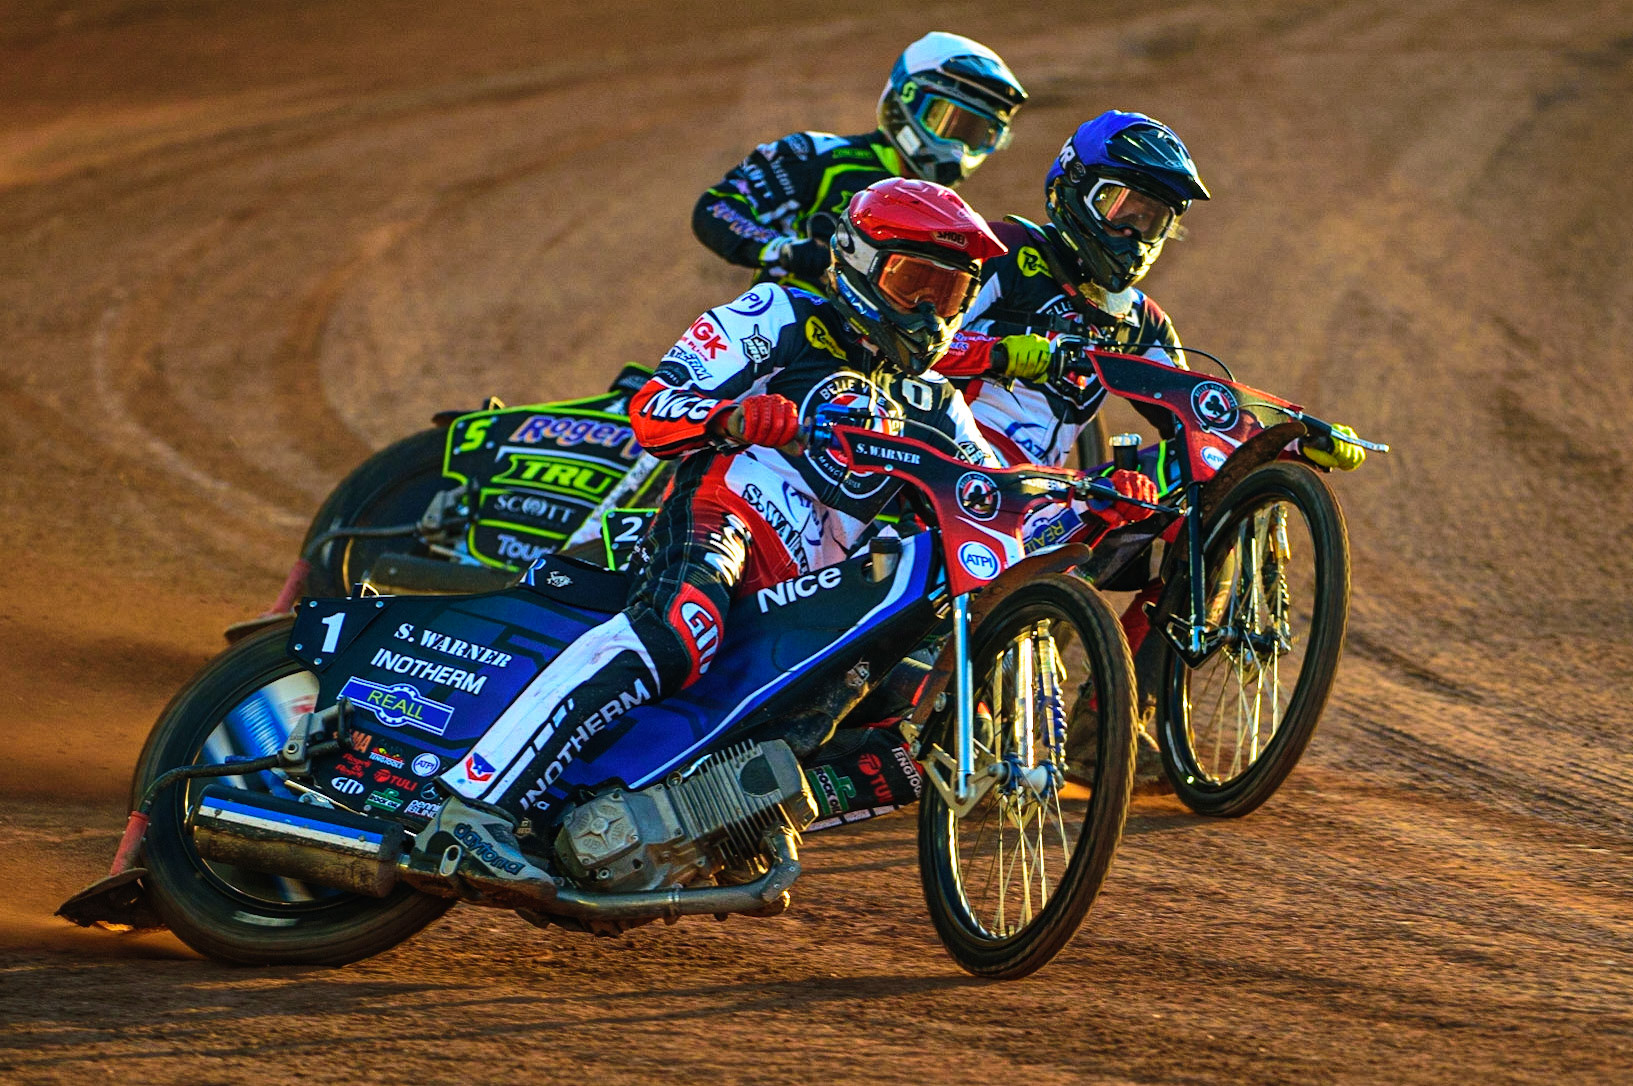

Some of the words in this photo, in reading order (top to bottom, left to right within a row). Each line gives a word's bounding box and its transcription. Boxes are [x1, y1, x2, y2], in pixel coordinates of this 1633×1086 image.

[690, 316, 728, 360] GK
[508, 414, 634, 447] Roger
[869, 445, 921, 465] WARNER
[493, 494, 576, 523] SCOTT
[614, 516, 643, 542] 2
[757, 567, 842, 614] Nice
[321, 612, 346, 653] 1
[394, 622, 415, 643] S.
[420, 629, 513, 668] WARNER
[370, 647, 488, 695] INOTHERM
[366, 688, 423, 721] REALL
[520, 678, 651, 811] INOTHERM
